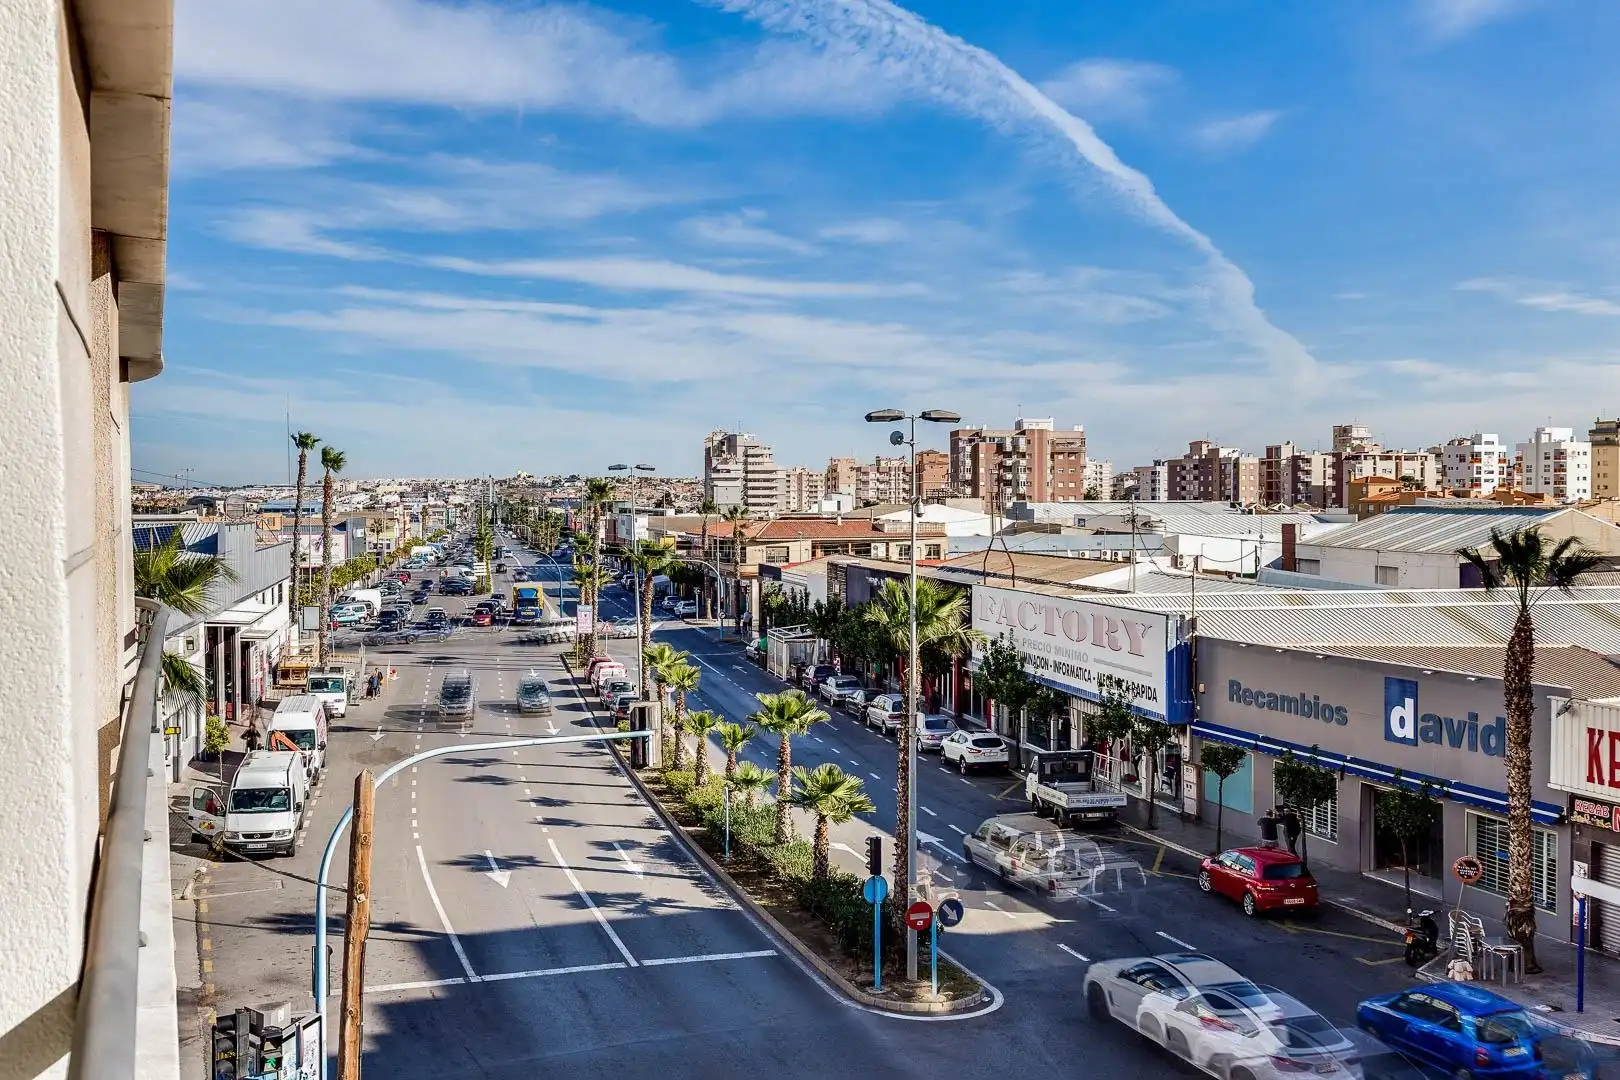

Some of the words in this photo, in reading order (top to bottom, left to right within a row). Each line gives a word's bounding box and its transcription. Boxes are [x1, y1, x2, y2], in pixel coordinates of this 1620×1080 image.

[977, 594, 1152, 657] FACTORY
[1022, 638, 1052, 654] PRECIO
[1054, 645, 1089, 663] MINIMO
[1052, 659, 1092, 683] INFORMATICA
[1131, 682, 1158, 702] RAPIDA
[1228, 679, 1348, 726] Recambios
[1390, 697, 1506, 757] david
[1575, 799, 1610, 818] KEBAB
